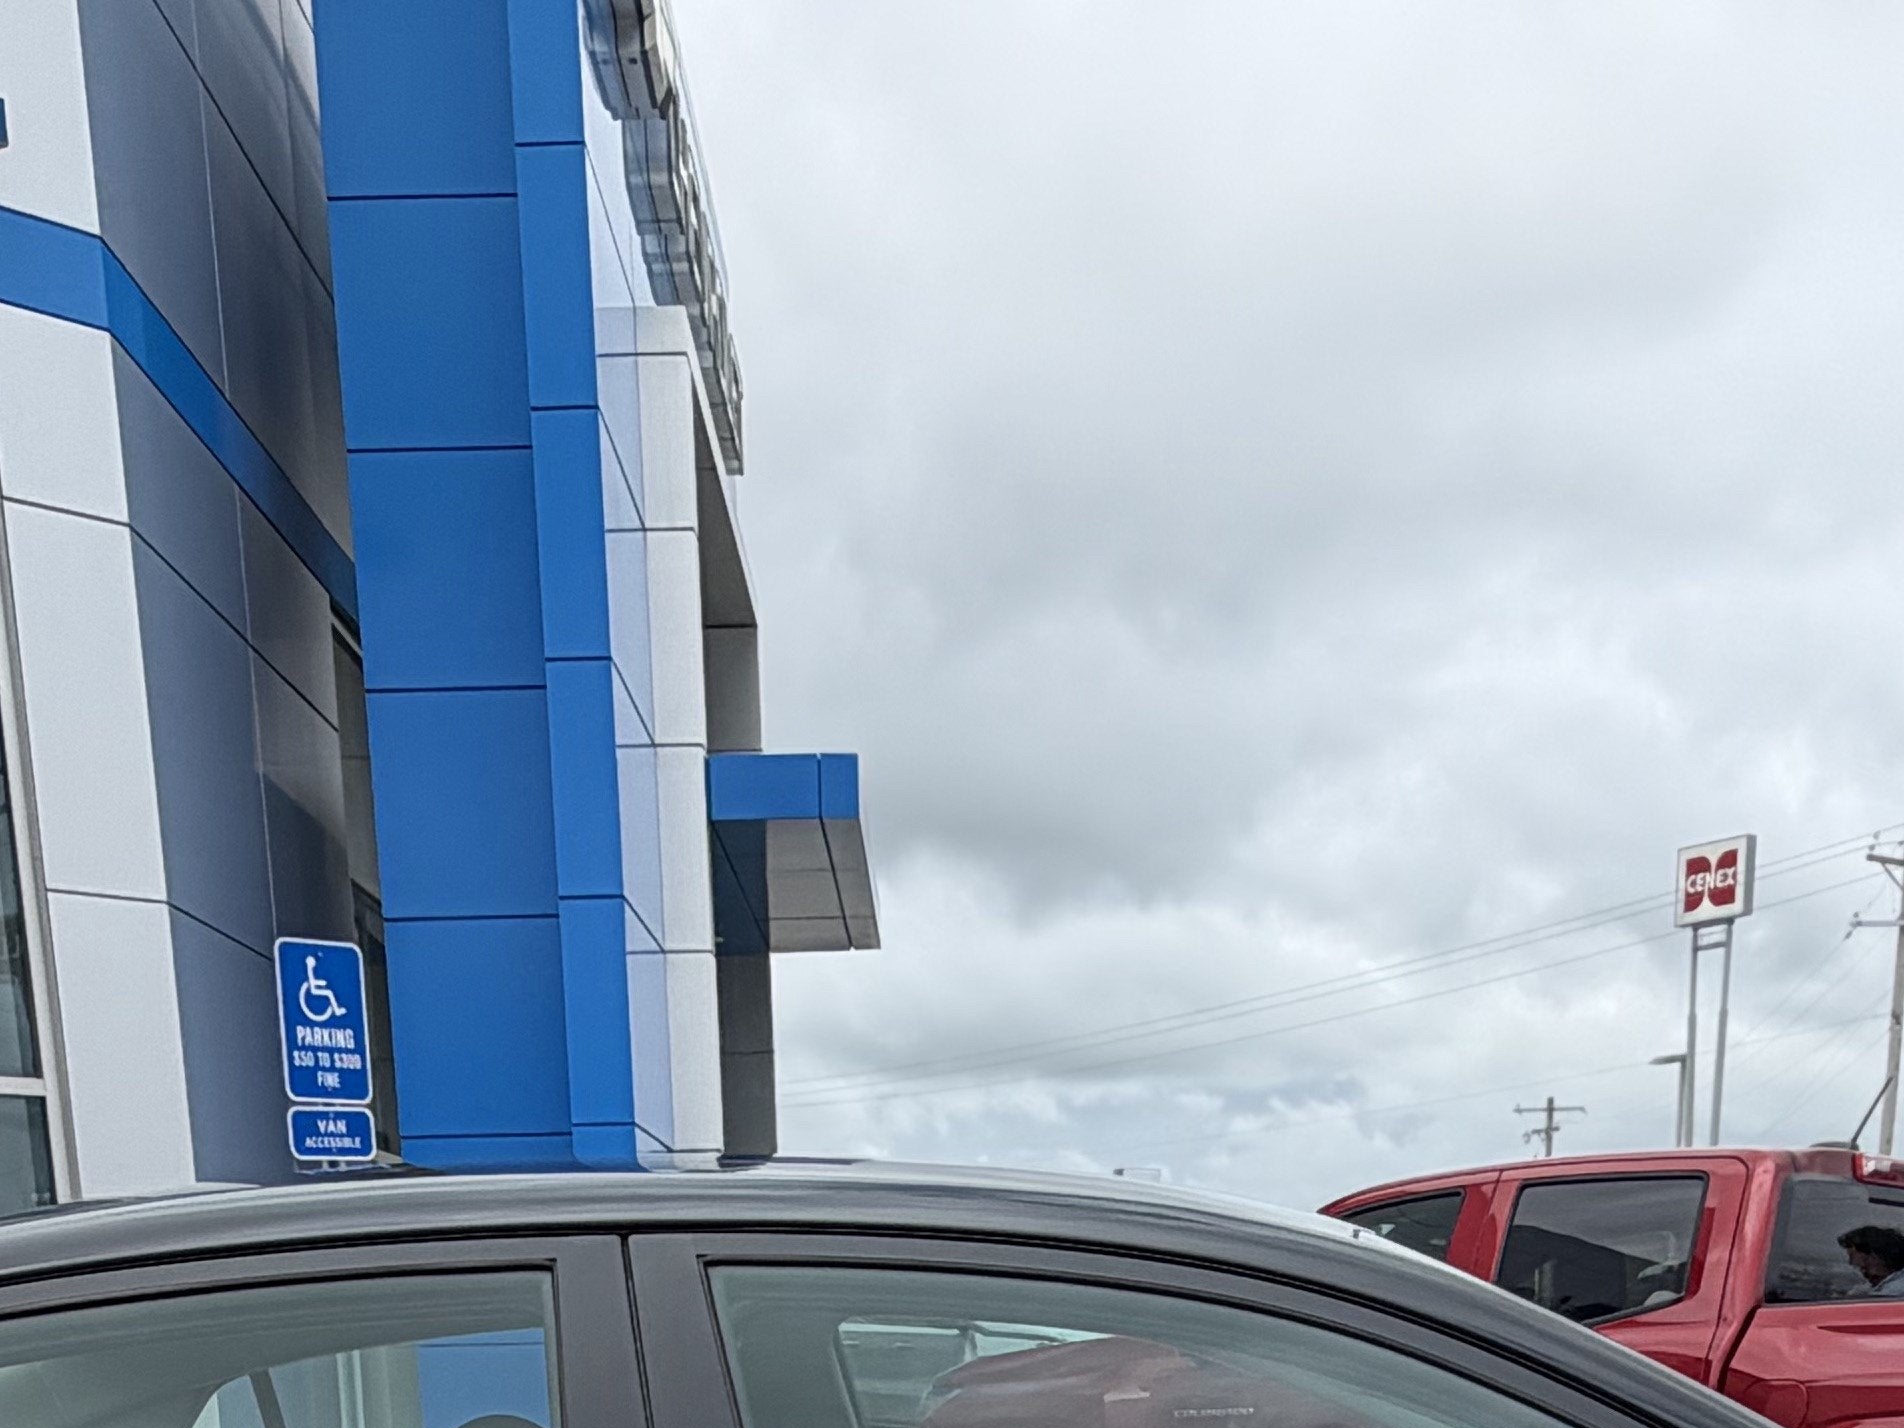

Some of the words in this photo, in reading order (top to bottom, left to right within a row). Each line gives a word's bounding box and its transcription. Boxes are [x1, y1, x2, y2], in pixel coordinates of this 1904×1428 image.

[1687, 866, 1737, 894] CENEX
[296, 1025, 356, 1049] PARKING
[293, 1050, 315, 1068] $50
[317, 1052, 331, 1068] TO
[317, 1070, 341, 1088] FINE
[317, 1119, 347, 1134] VAN
[305, 1136, 362, 1150] ACCESSIBLE
